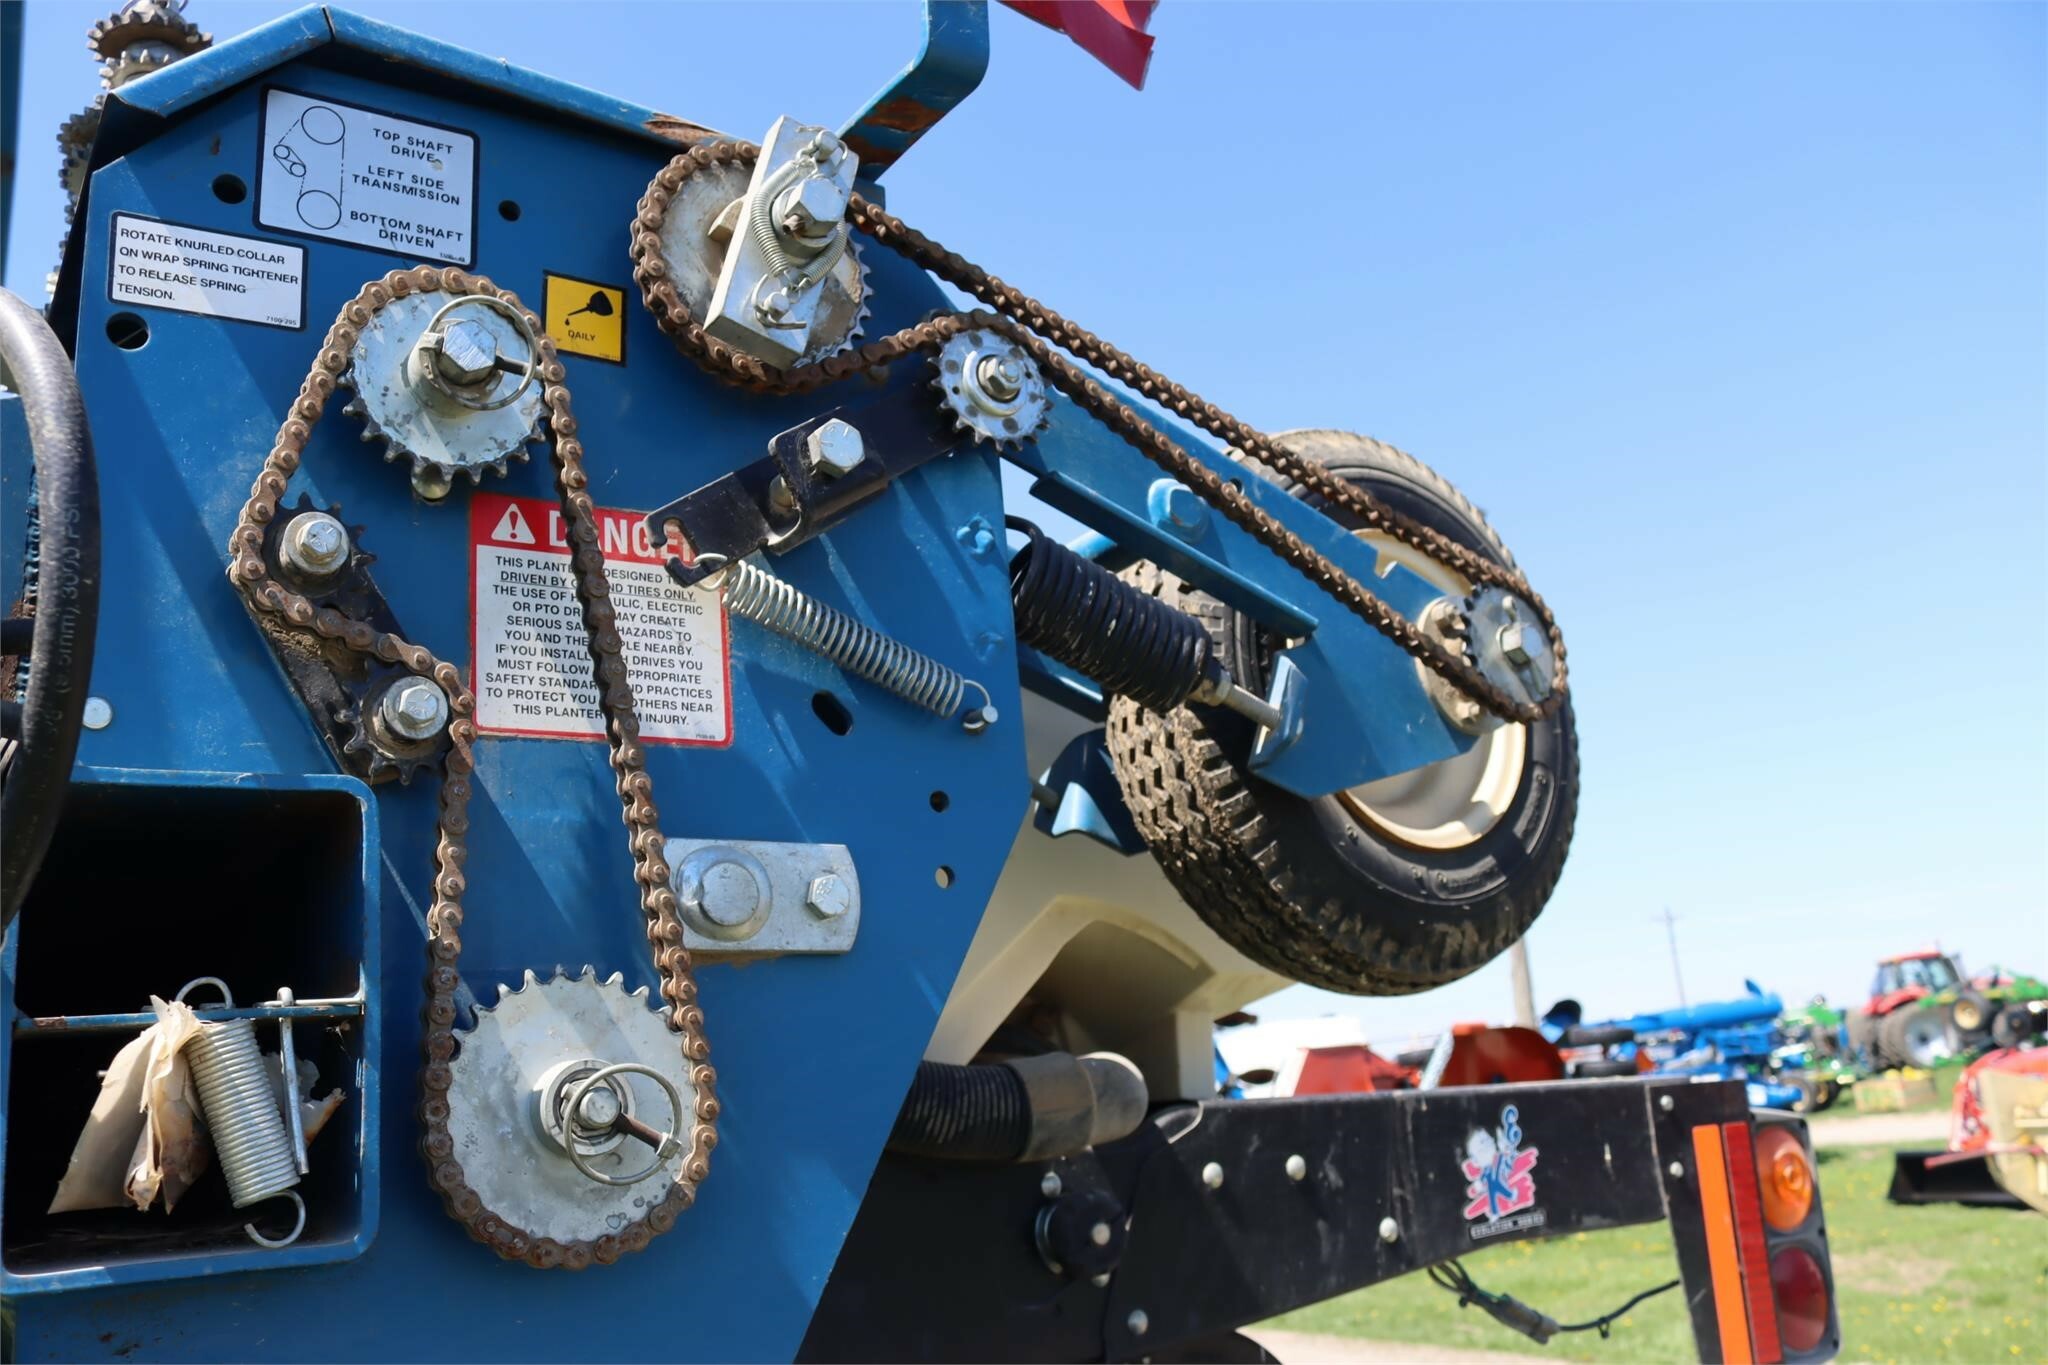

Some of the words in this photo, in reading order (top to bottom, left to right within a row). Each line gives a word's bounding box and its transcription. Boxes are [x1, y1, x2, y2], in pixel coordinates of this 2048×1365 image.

[373, 128, 400, 142] TOP
[407, 137, 453, 154] SHAFT
[391, 145, 434, 162] DRIVE
[352, 174, 460, 205] TRANSMISSION
[368, 165, 404, 181] LEFT
[411, 175, 444, 190] SIDE
[350, 211, 411, 231] BOTTOM
[416, 220, 463, 242] SHAFT
[378, 229, 434, 248] DRIVEN
[120, 228, 171, 246] ROTATE
[175, 238, 234, 256] KNURLED
[237, 250, 285, 265] COLLAR
[118, 265, 136, 276] TO
[139, 268, 197, 286] RELEASE
[200, 278, 246, 294] SPRING
[119, 247, 138, 258] ON
[142, 251, 179, 264] WRAP
[183, 257, 229, 273] SPRING
[232, 265, 298, 285] TIGHTENER
[117, 283, 176, 301] TENSION.
[568, 330, 596, 341] DAILY
[496, 555, 523, 568] THIS
[527, 558, 573, 574] PLANTE
[604, 568, 663, 584] DESIGNED
[493, 584, 517, 597] THE
[521, 588, 547, 599] USE
[550, 590, 567, 601] OF
[647, 601, 703, 615] ELECTRIC
[501, 571, 547, 585] DRIVEN
[551, 577, 567, 588] BY
[627, 585, 661, 598] TIRES
[664, 589, 696, 602] ONLY.
[513, 602, 531, 612] OR
[535, 603, 559, 614] PTO
[615, 612, 636, 623] MAY
[640, 614, 686, 628] CREATE
[505, 629, 531, 641] YOU
[535, 633, 561, 645] AND
[565, 635, 589, 647] THE
[645, 643, 694, 657] NEARBY.
[507, 616, 562, 631] SERIOUS
[617, 627, 673, 641] HAZARDS
[676, 631, 692, 643] TO
[495, 644, 506, 654] IF
[510, 645, 537, 657] YOU
[541, 649, 591, 661] INSTALL
[632, 656, 675, 669] DRIVES
[679, 660, 703, 671] YOU
[485, 672, 534, 686] SAFETY
[646, 685, 713, 699] PRACTICES
[497, 659, 532, 671] MUST
[537, 662, 590, 675] FOLLOW
[628, 670, 702, 685] PPROPRIATE
[486, 687, 503, 699] TO
[507, 689, 566, 703] PROTECT
[570, 693, 596, 705] YOU
[681, 702, 713, 714] NEAR
[513, 703, 541, 716] THIS
[545, 706, 603, 720] PLANTER
[645, 714, 690, 726] INJURY.
